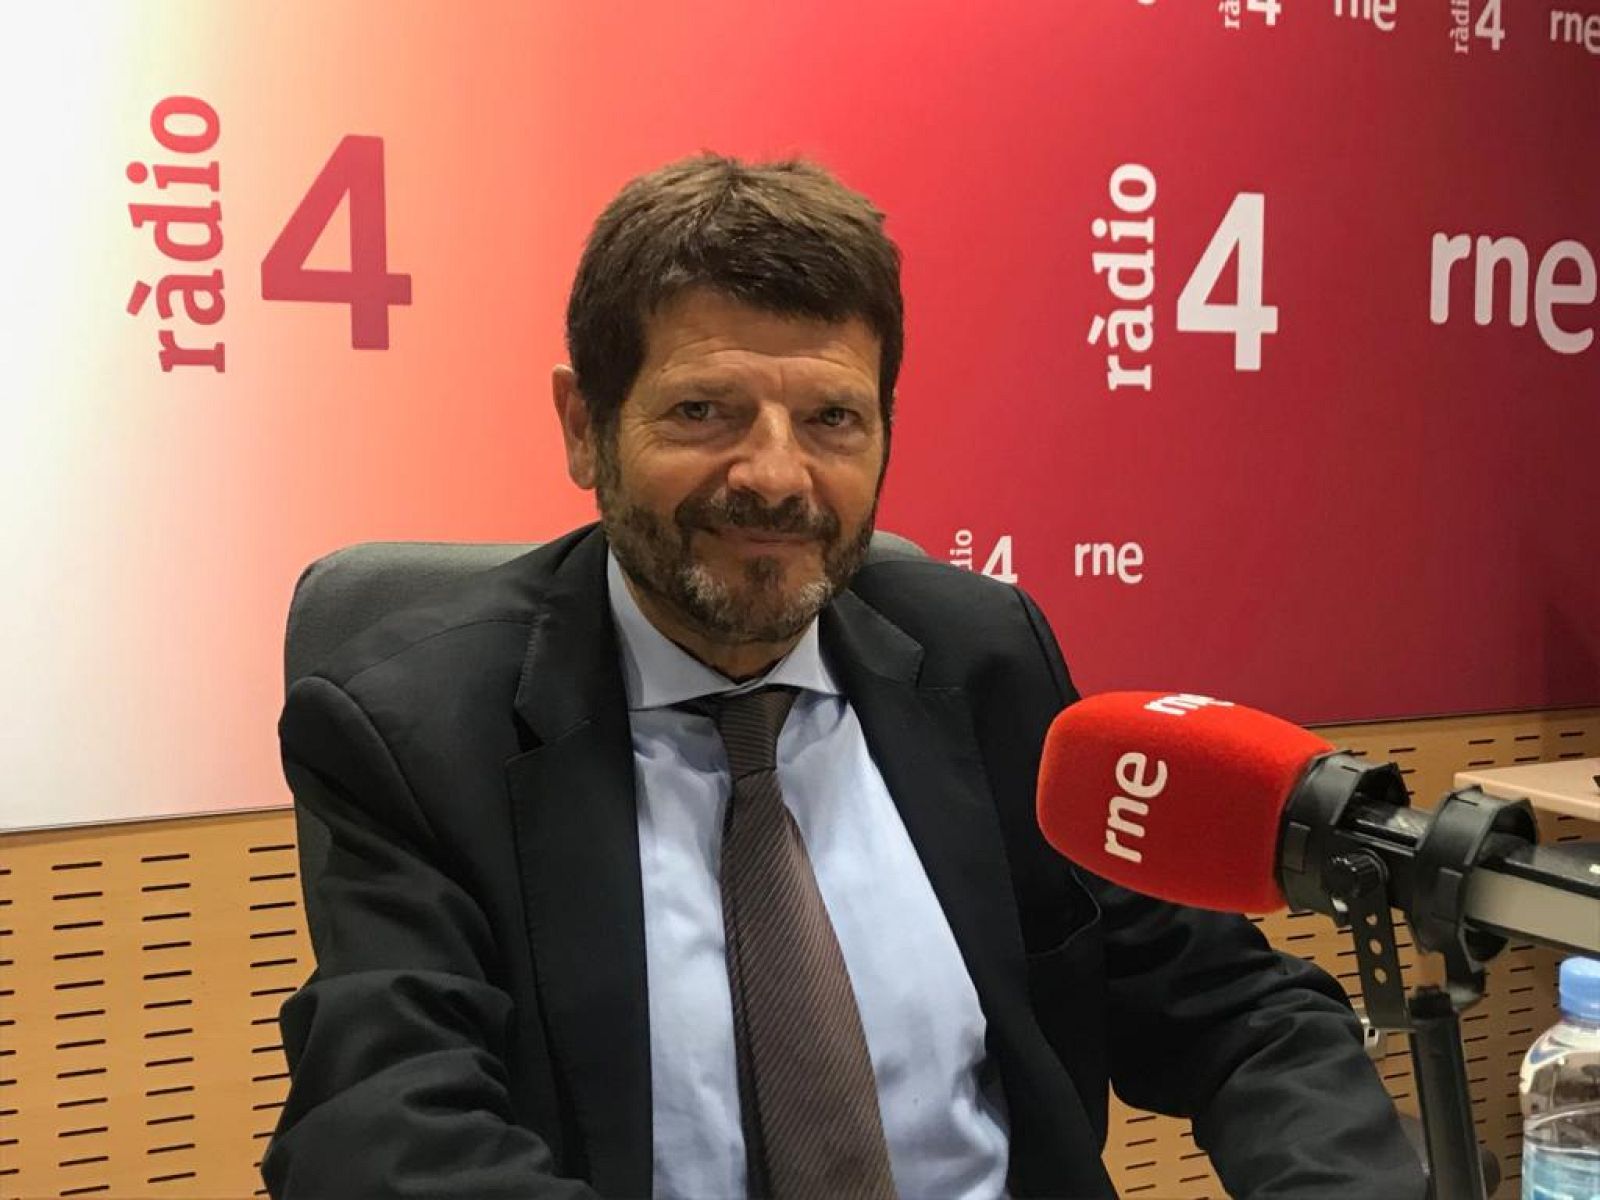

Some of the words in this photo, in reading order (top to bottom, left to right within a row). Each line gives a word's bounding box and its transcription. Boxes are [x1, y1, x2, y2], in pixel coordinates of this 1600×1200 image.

[1474, 0, 1506, 51] 4
[1551, 10, 1600, 54] rne
[125, 95, 226, 373] ràdio
[261, 133, 413, 350] 4
[1087, 163, 1157, 392] ràdio
[1176, 191, 1279, 371] 4
[1430, 231, 1598, 355] rne
[981, 535, 1018, 584] 4
[1074, 541, 1144, 584] rne
[1104, 751, 1168, 864] rne
